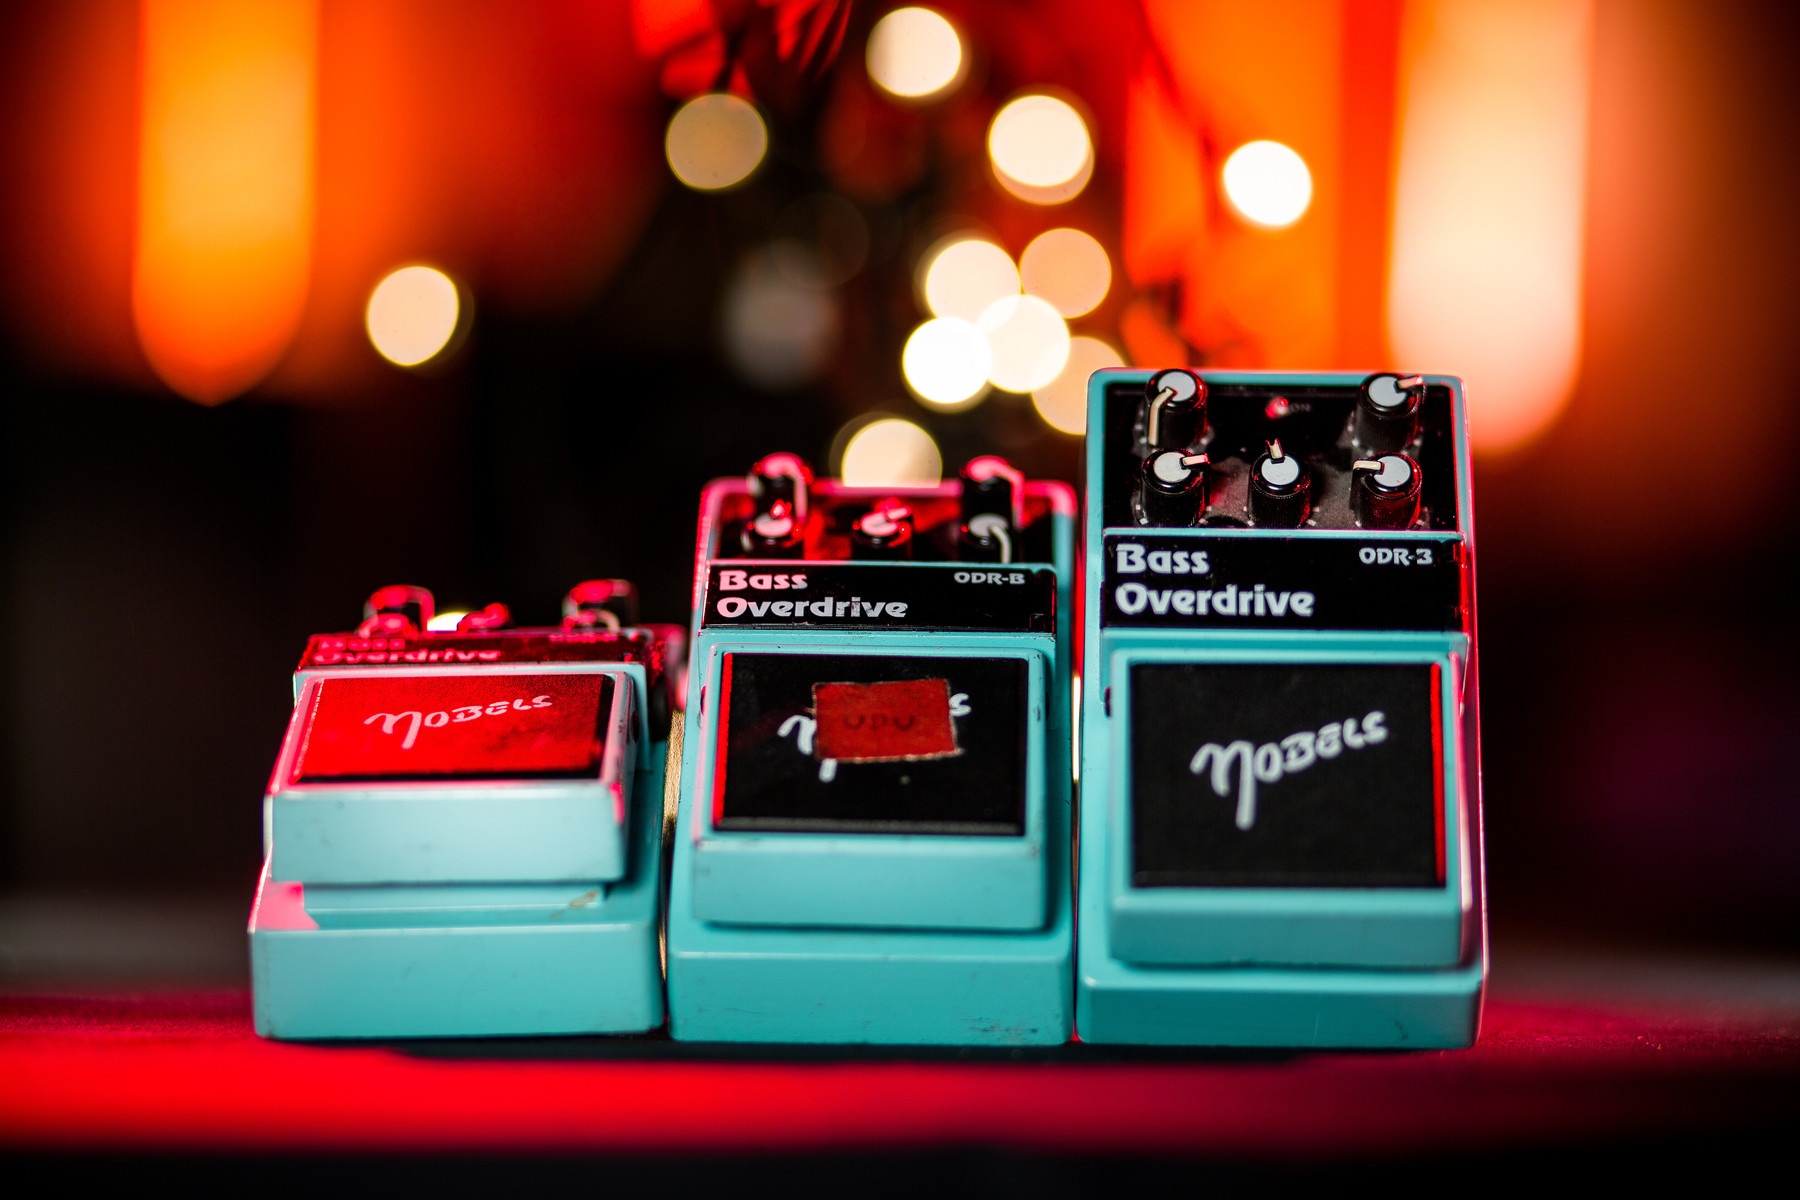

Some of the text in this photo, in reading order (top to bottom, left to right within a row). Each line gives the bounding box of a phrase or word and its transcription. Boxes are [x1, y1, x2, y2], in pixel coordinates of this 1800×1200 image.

[1116, 543, 1210, 575] Bass
[719, 569, 809, 591] Bass
[953, 571, 1026, 586] ODR-B
[716, 596, 909, 619] Overdrive
[1114, 583, 1315, 616] Overdrive
[313, 648, 502, 664] Overdrive
